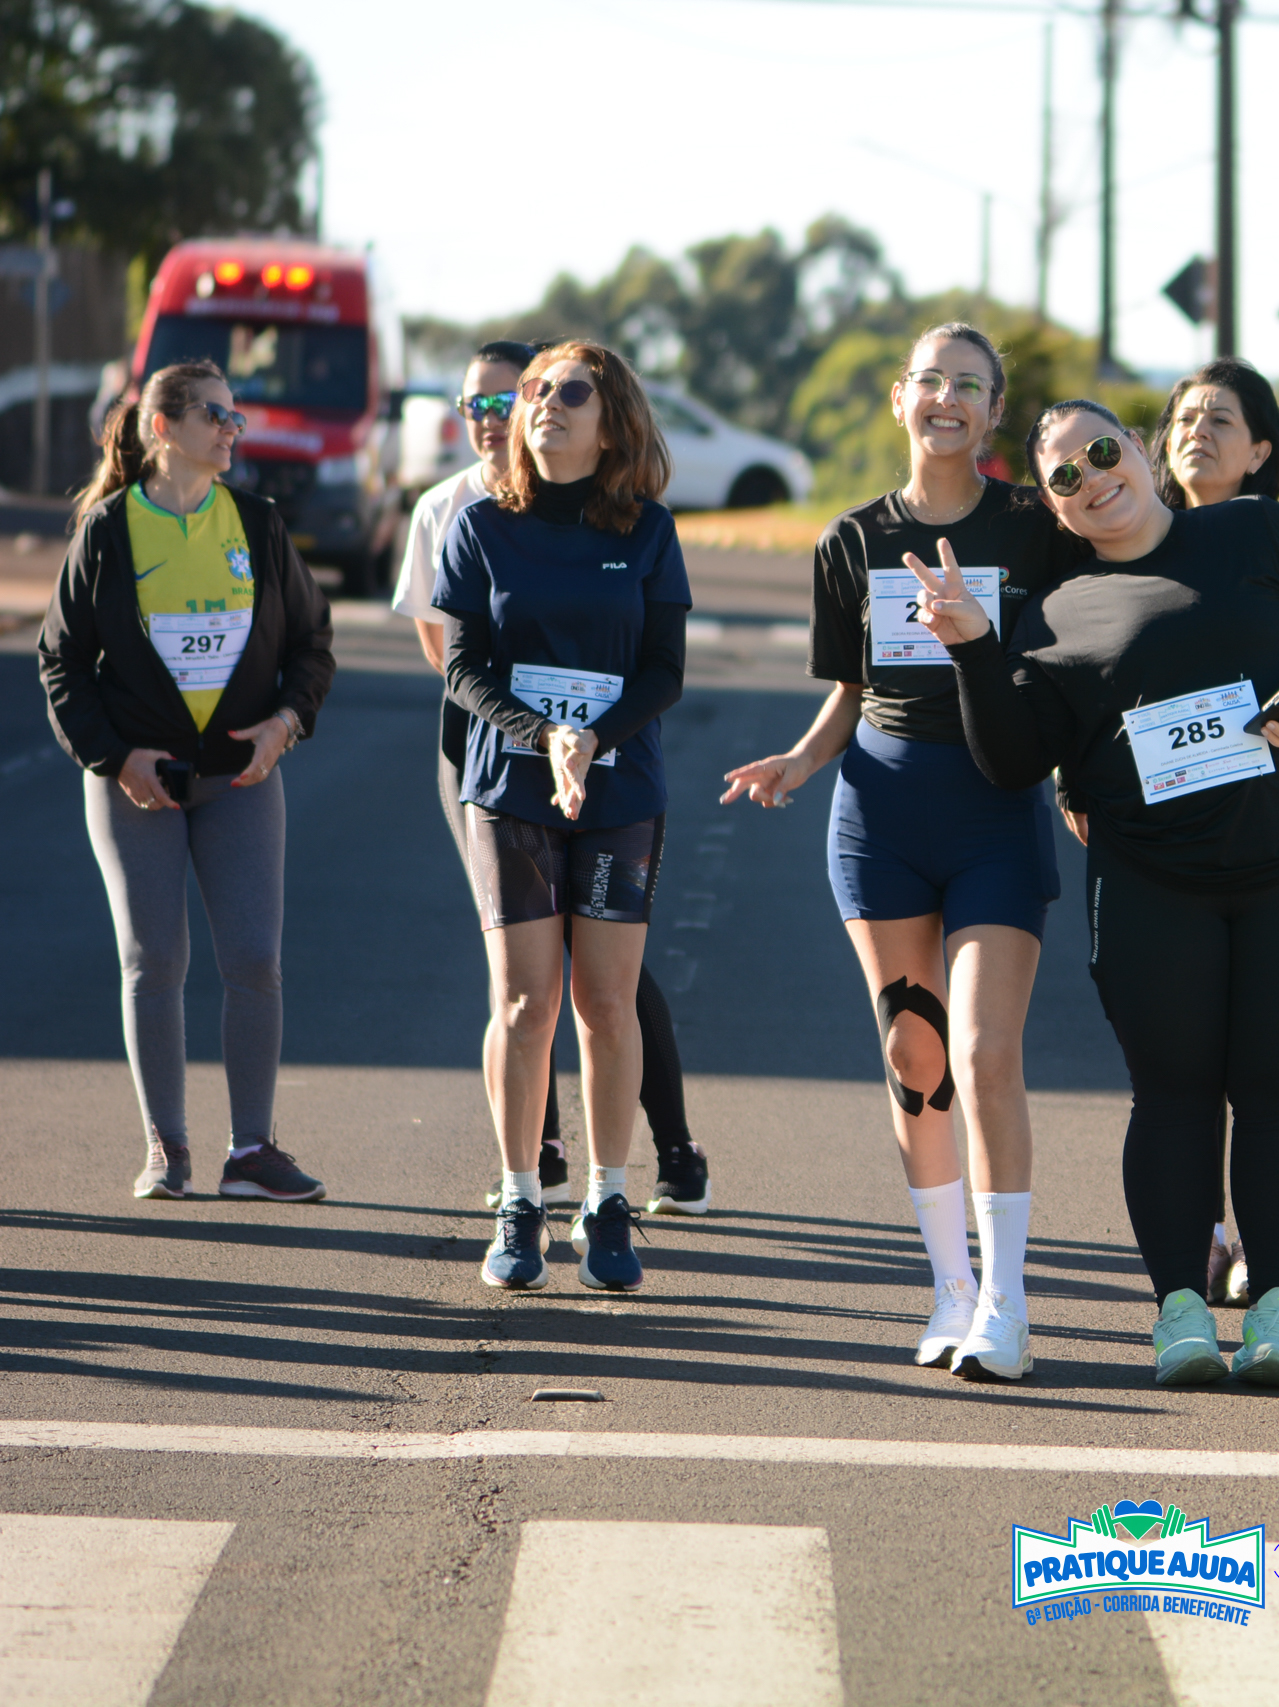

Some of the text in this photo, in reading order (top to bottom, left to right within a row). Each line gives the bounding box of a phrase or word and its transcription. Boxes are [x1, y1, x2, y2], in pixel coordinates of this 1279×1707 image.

[231, 587, 253, 596] BRAS
[181, 634, 226, 653] 297
[539, 697, 589, 723] 314
[1168, 716, 1225, 750] 285
[1094, 877, 1102, 908] WOMEN
[1091, 930, 1099, 964] INSPIRE
